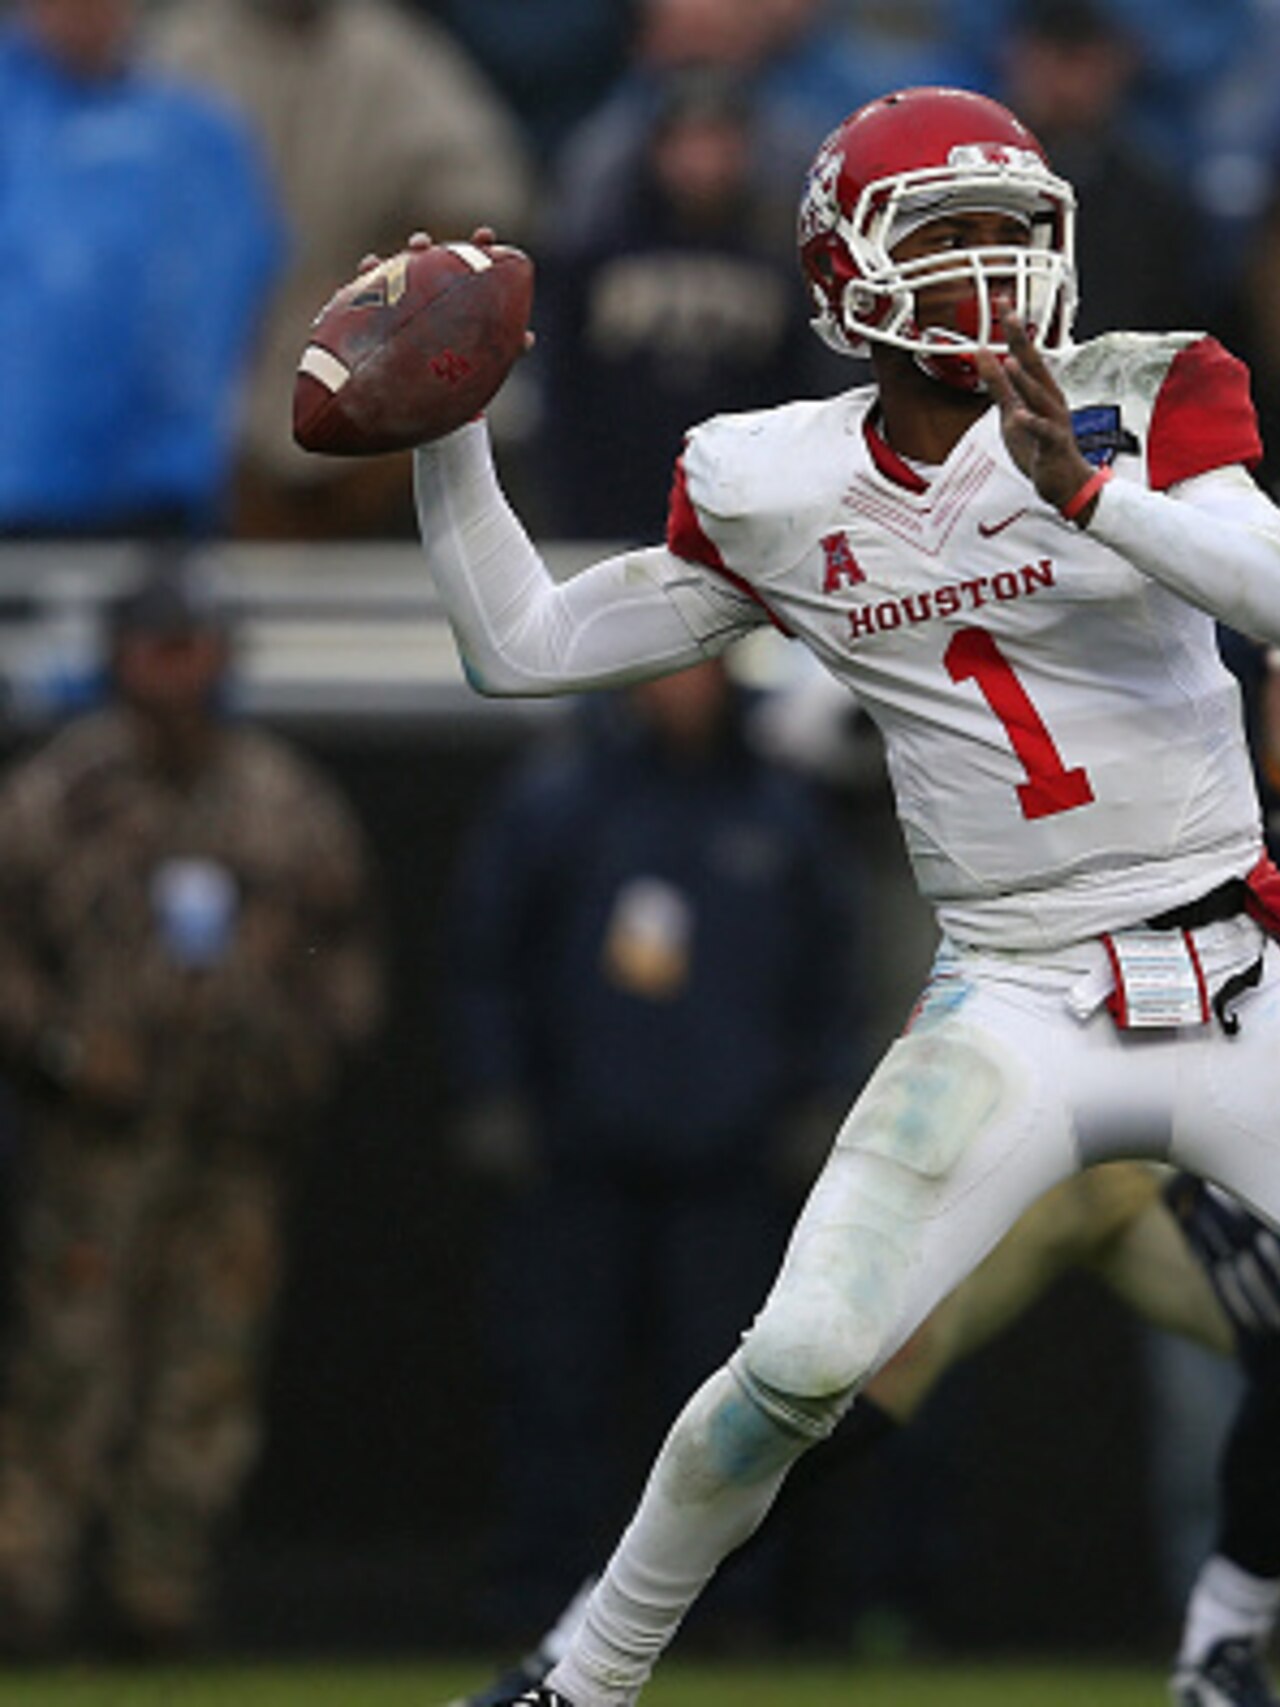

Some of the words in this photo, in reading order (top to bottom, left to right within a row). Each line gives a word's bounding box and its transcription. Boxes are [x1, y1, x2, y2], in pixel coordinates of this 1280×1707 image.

[819, 530, 867, 594] A
[848, 559, 1056, 638] HOUSTON
[942, 627, 1094, 820] 1
